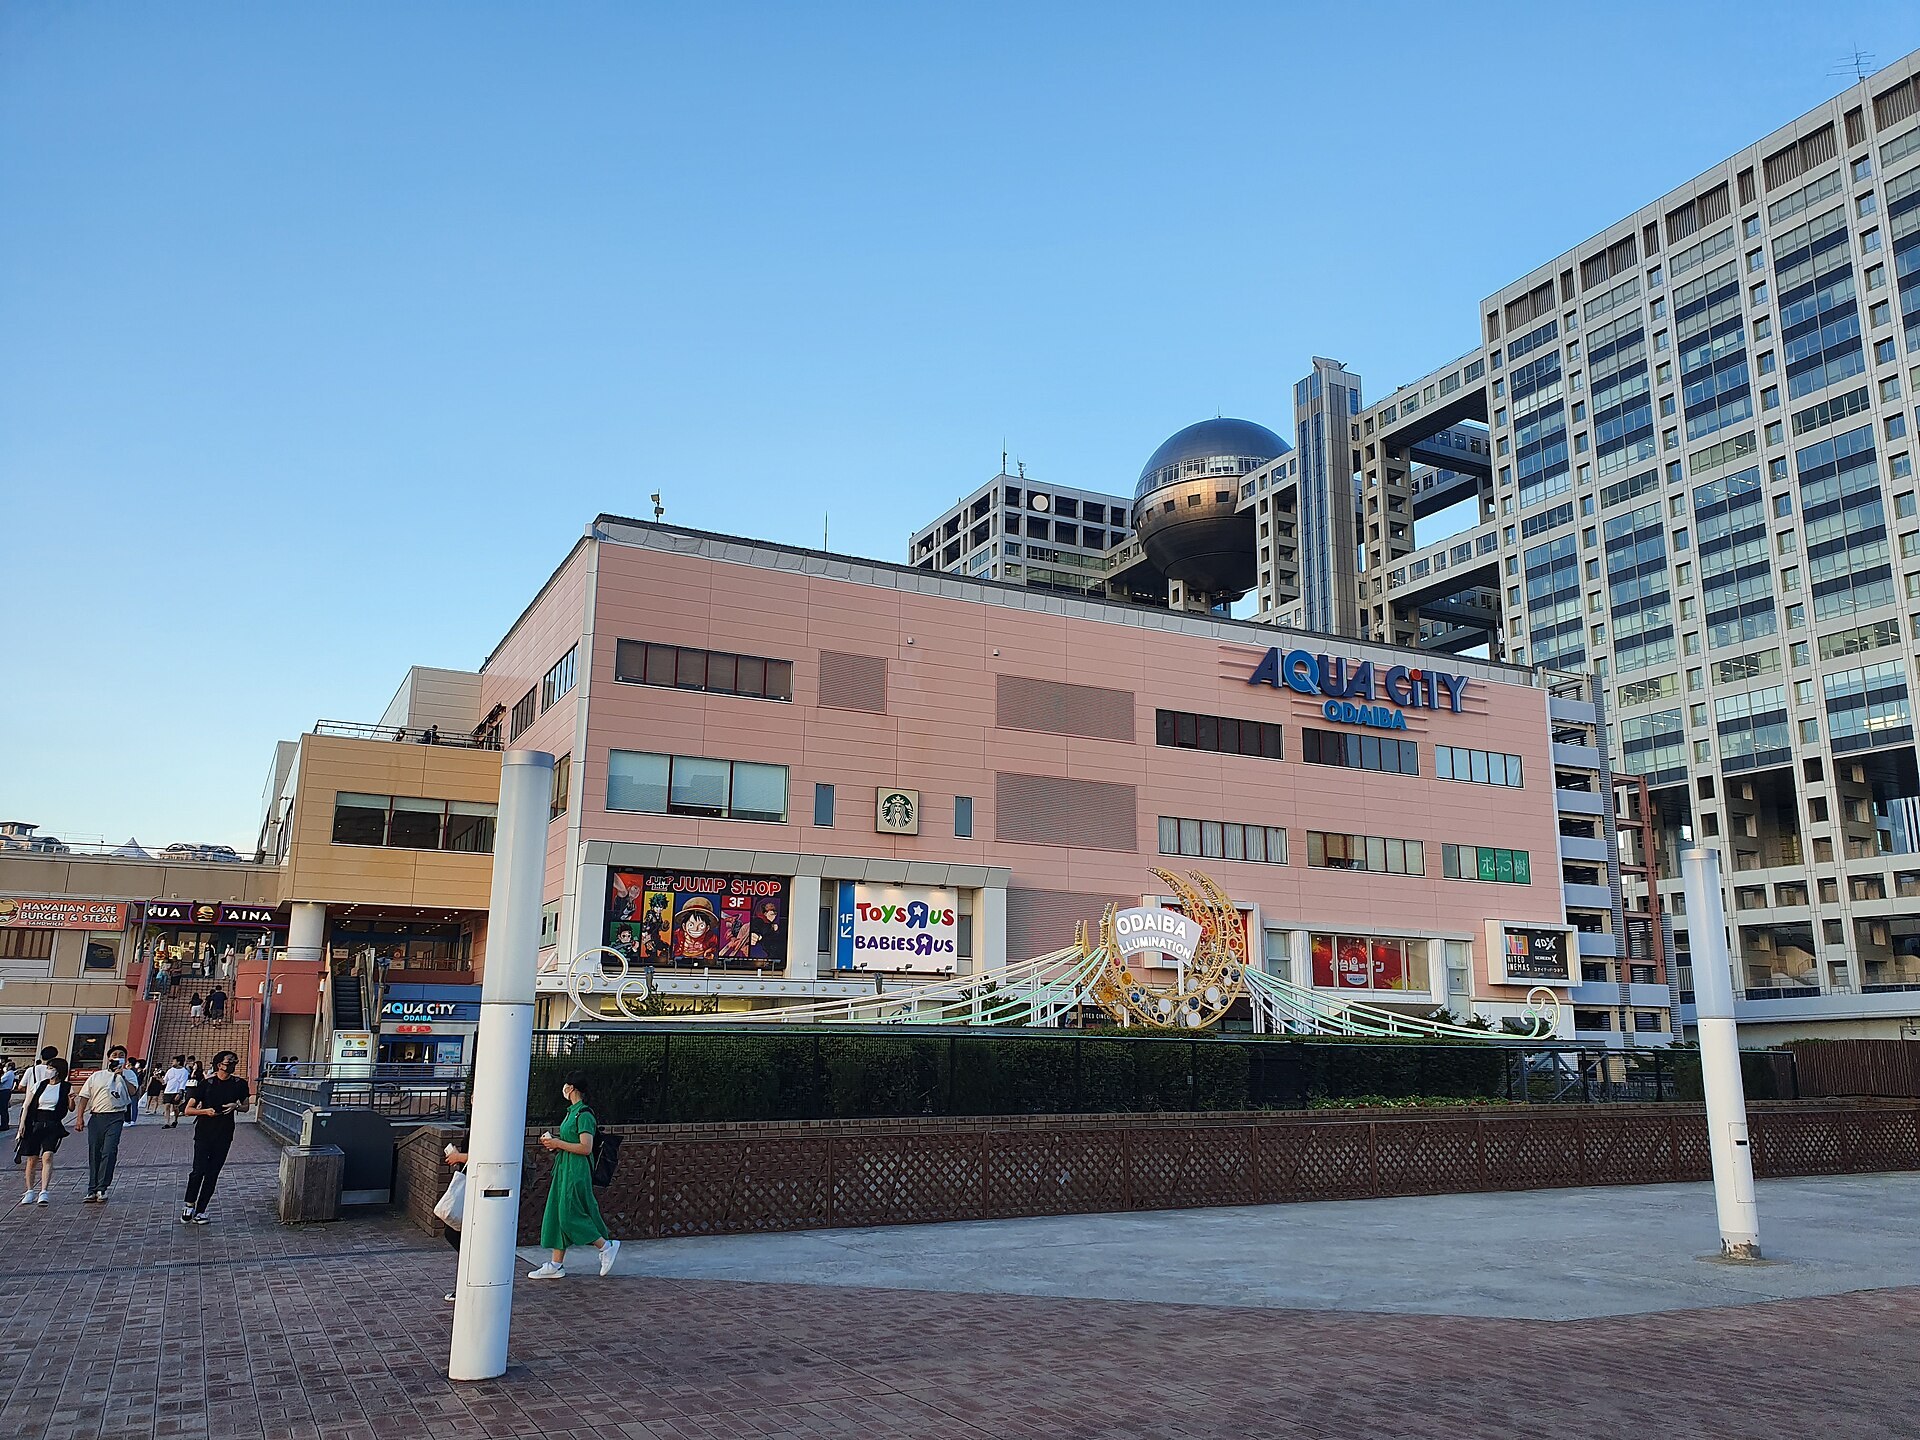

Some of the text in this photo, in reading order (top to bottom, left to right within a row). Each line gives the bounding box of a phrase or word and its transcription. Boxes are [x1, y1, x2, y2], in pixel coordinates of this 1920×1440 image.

[1248, 647, 1376, 700] AQUA
[1322, 700, 1408, 731] ODAIBA
[673, 875, 781, 896] JUMP SHOP
[22, 902, 117, 914] HAWAIIAN CAFÉ
[729, 896, 744, 908] 3F
[20, 912, 117, 923] BURGER & STEAK
[840, 913, 854, 924] 1F
[1116, 913, 1186, 939] ODAIBA
[1119, 936, 1192, 960] LLUMINATION
[1534, 936, 1557, 951] 4DX
[1507, 955, 1525, 964] NITED
[1507, 963, 1530, 972] INEMAS
[381, 1002, 425, 1014] AQUA
[403, 1014, 433, 1022] ODAIBA
